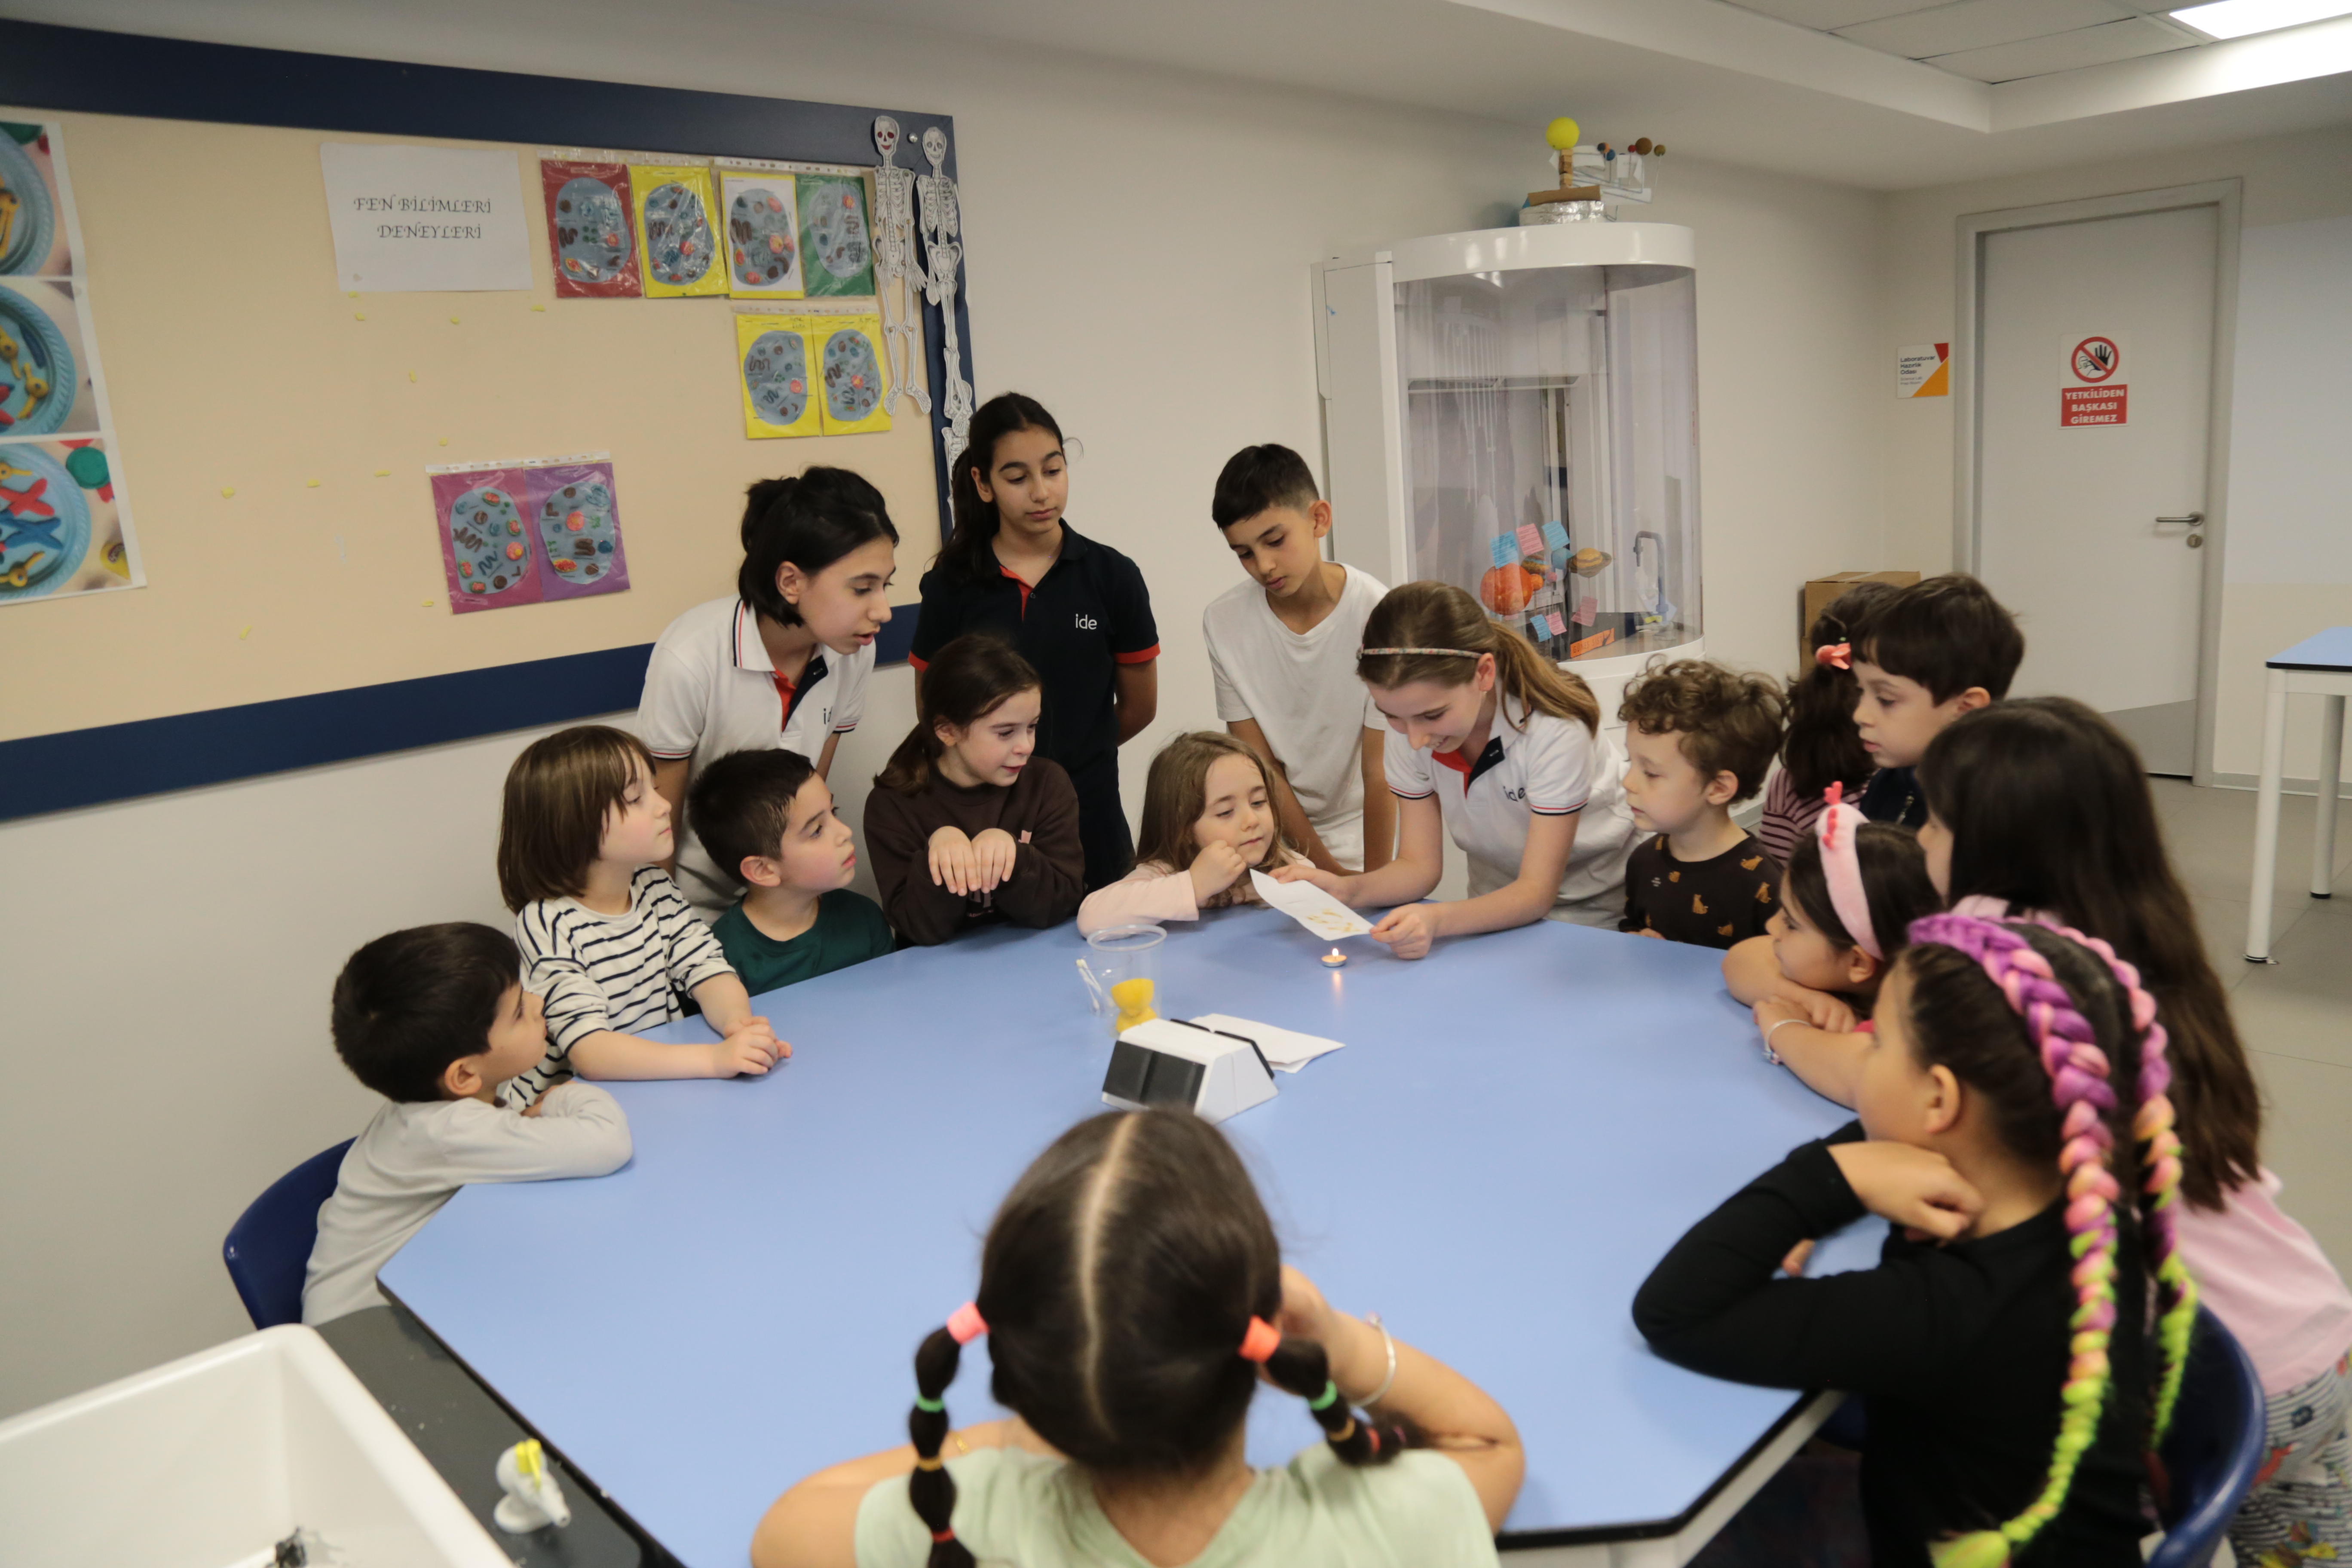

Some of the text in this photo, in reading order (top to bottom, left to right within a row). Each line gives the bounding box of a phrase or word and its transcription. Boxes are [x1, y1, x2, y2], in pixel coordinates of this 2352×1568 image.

[354, 195, 491, 214] FEN BİLİMLERİ
[377, 222, 482, 239] DENEYLERİ
[2065, 388, 2125, 400] YETKİLİDEN
[2071, 402, 2117, 413] BAŞKASI
[2070, 414, 2117, 424] GİREMEZ
[1075, 613, 1097, 630] ide
[823, 706, 833, 725] id
[1503, 786, 1526, 802] ide
